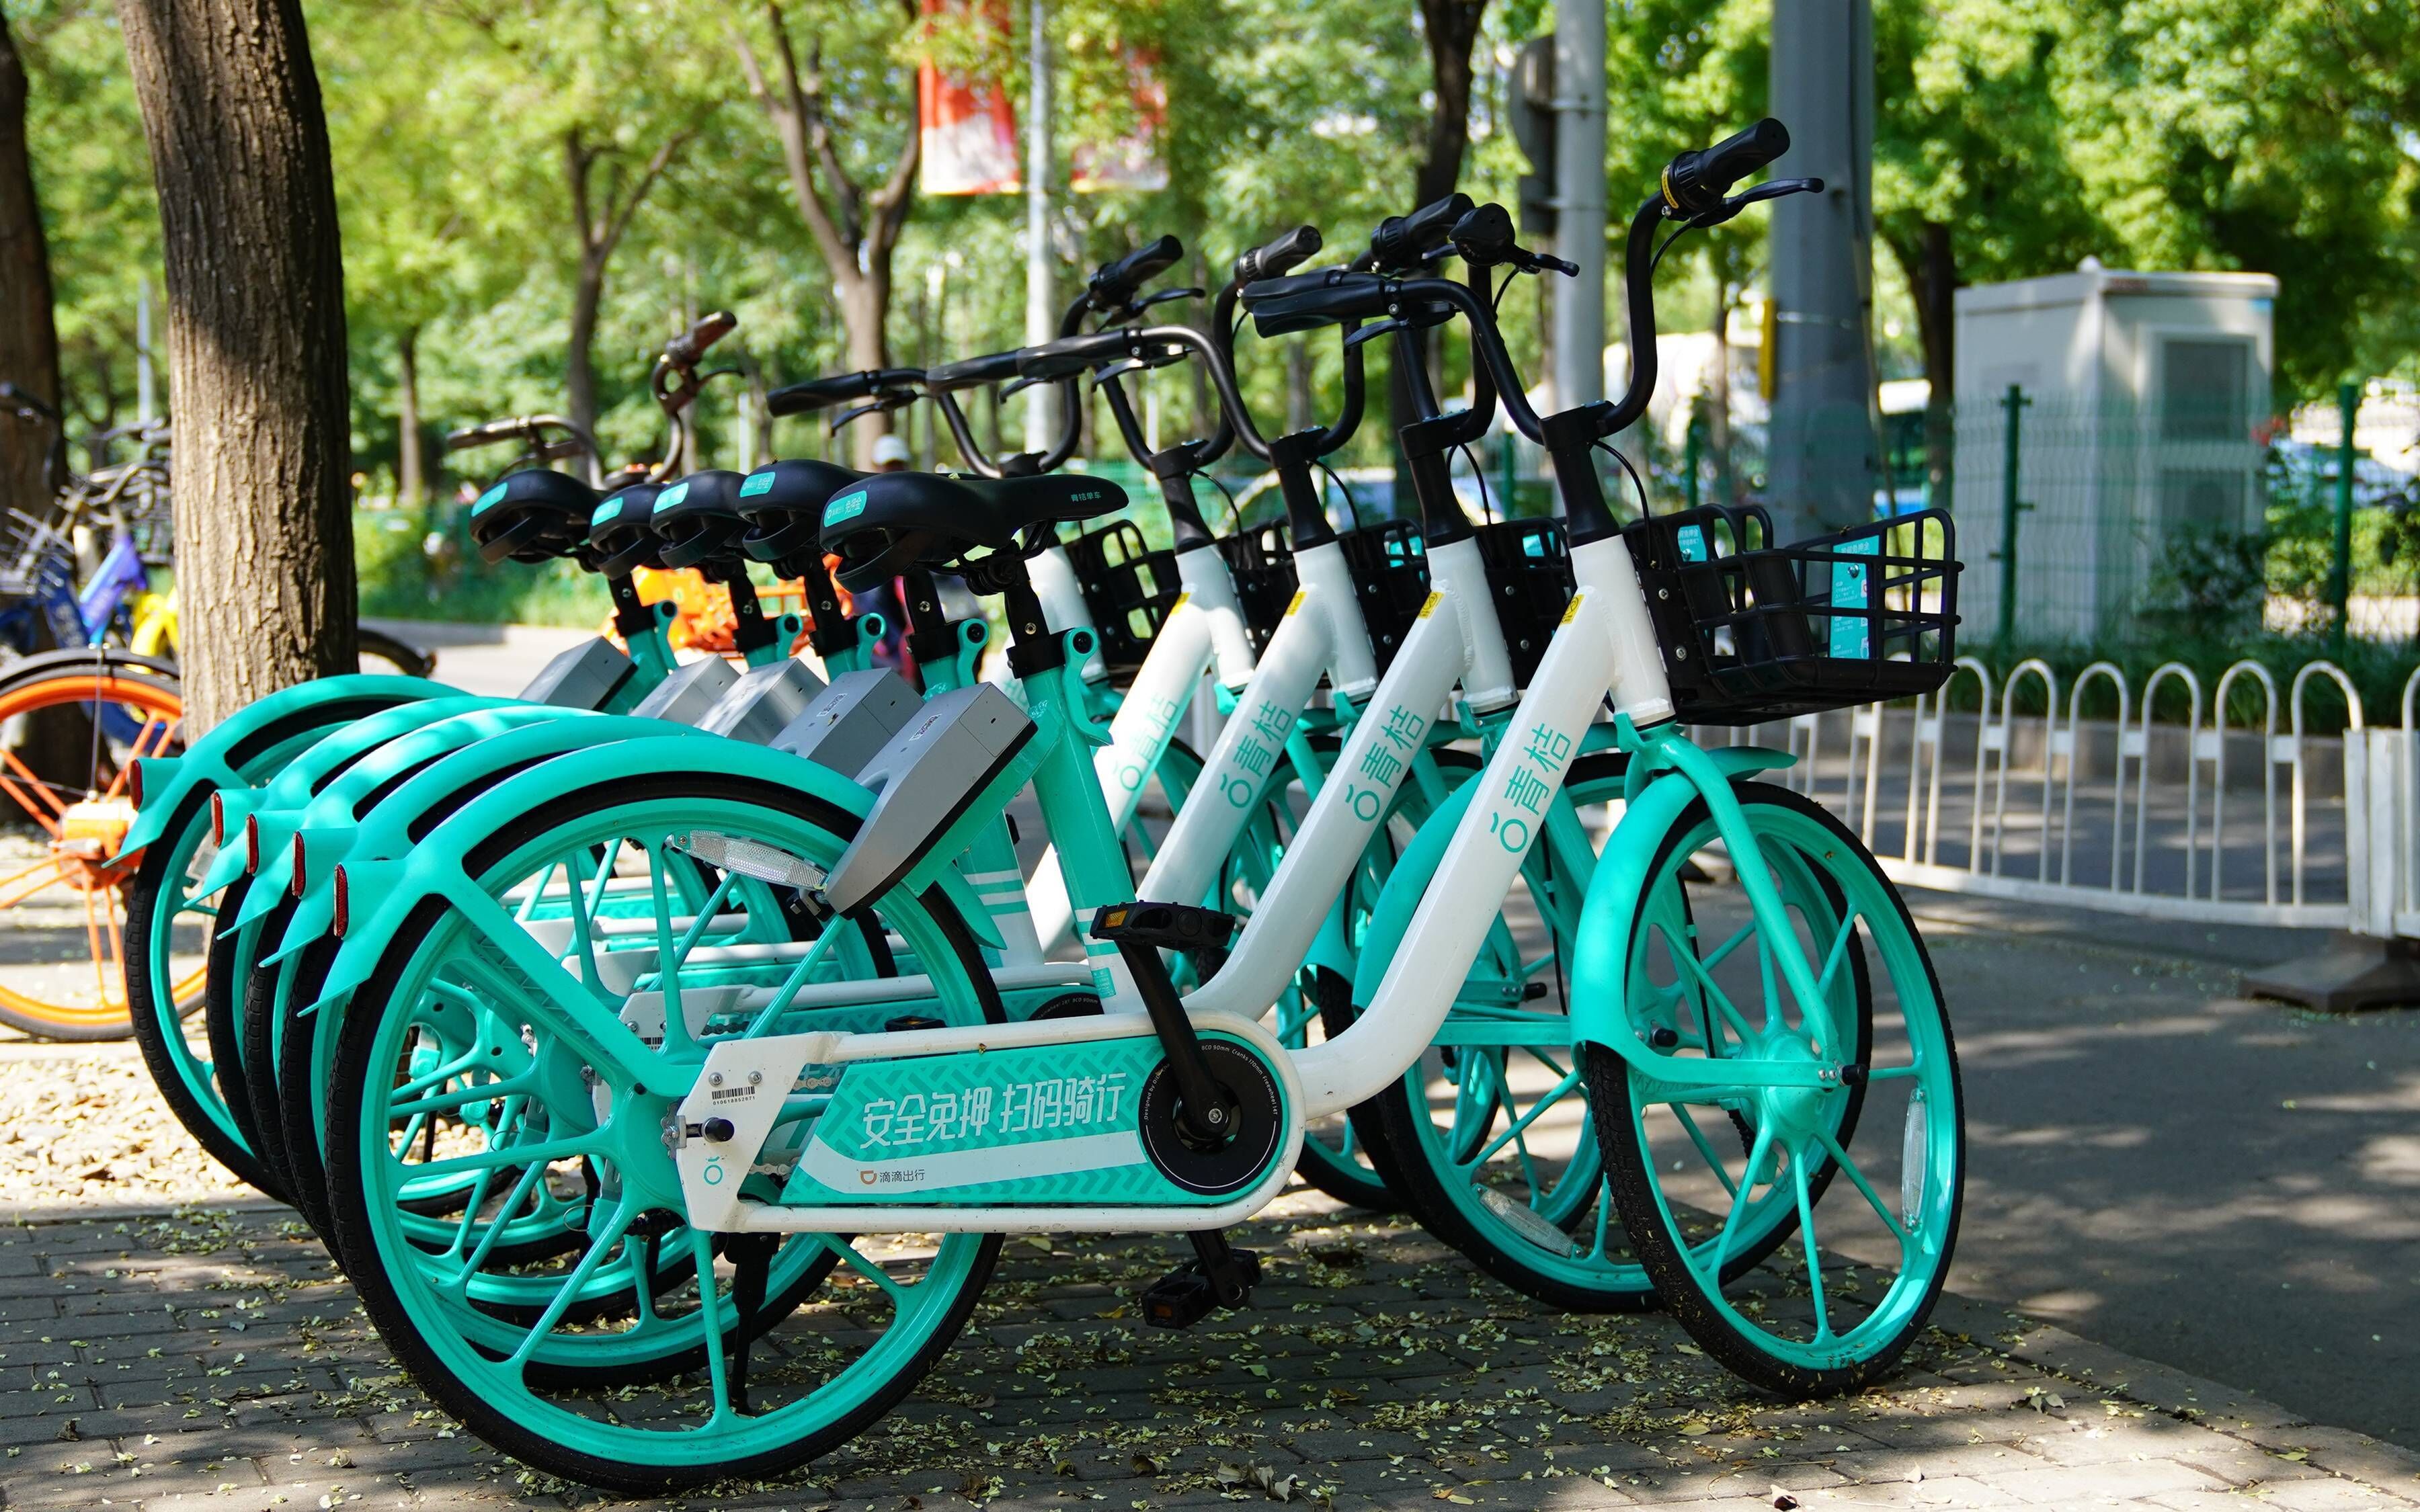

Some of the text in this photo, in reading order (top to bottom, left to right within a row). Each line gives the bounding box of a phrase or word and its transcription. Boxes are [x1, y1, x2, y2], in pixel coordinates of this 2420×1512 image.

[1070, 491, 1102, 502] 青桔单车
[1233, 700, 1291, 778] 青桔
[1360, 705, 1424, 789] 青桔
[1504, 723, 1571, 816] 青桔
[1143, 1092, 1152, 1120] Designed
[1149, 1084, 1156, 1092] by
[1232, 1048, 1248, 1061] Cranks
[1248, 1058, 1263, 1075] 170mm
[1262, 1075, 1277, 1104] Freewheel
[860, 1073, 1127, 1149] 安全免押 扫码骑行
[879, 1169, 926, 1183] 滴滴出行
